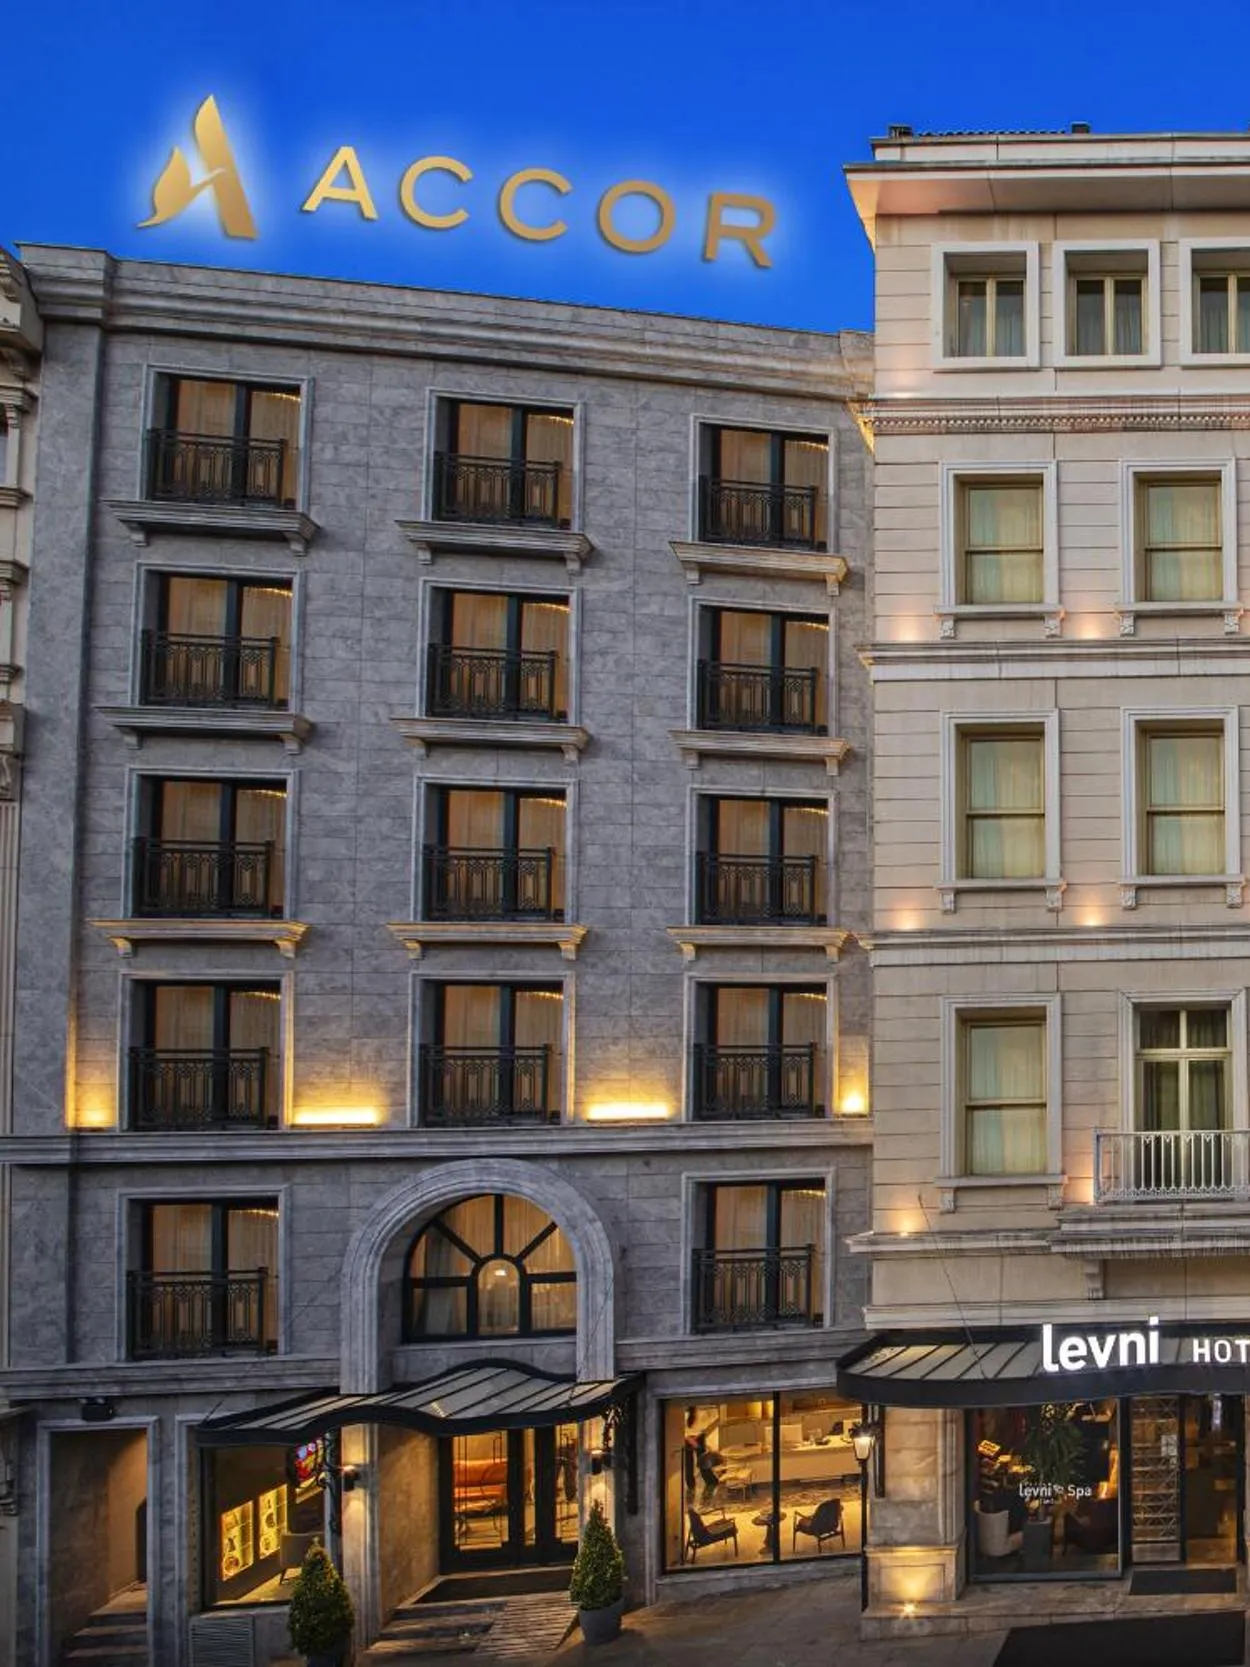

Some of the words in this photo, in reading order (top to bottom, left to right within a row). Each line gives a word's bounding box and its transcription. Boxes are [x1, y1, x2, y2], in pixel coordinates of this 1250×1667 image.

[301, 145, 777, 269] ACCOR
[1042, 1315, 1160, 1373] levni
[1067, 1484, 1093, 1500] Spa
